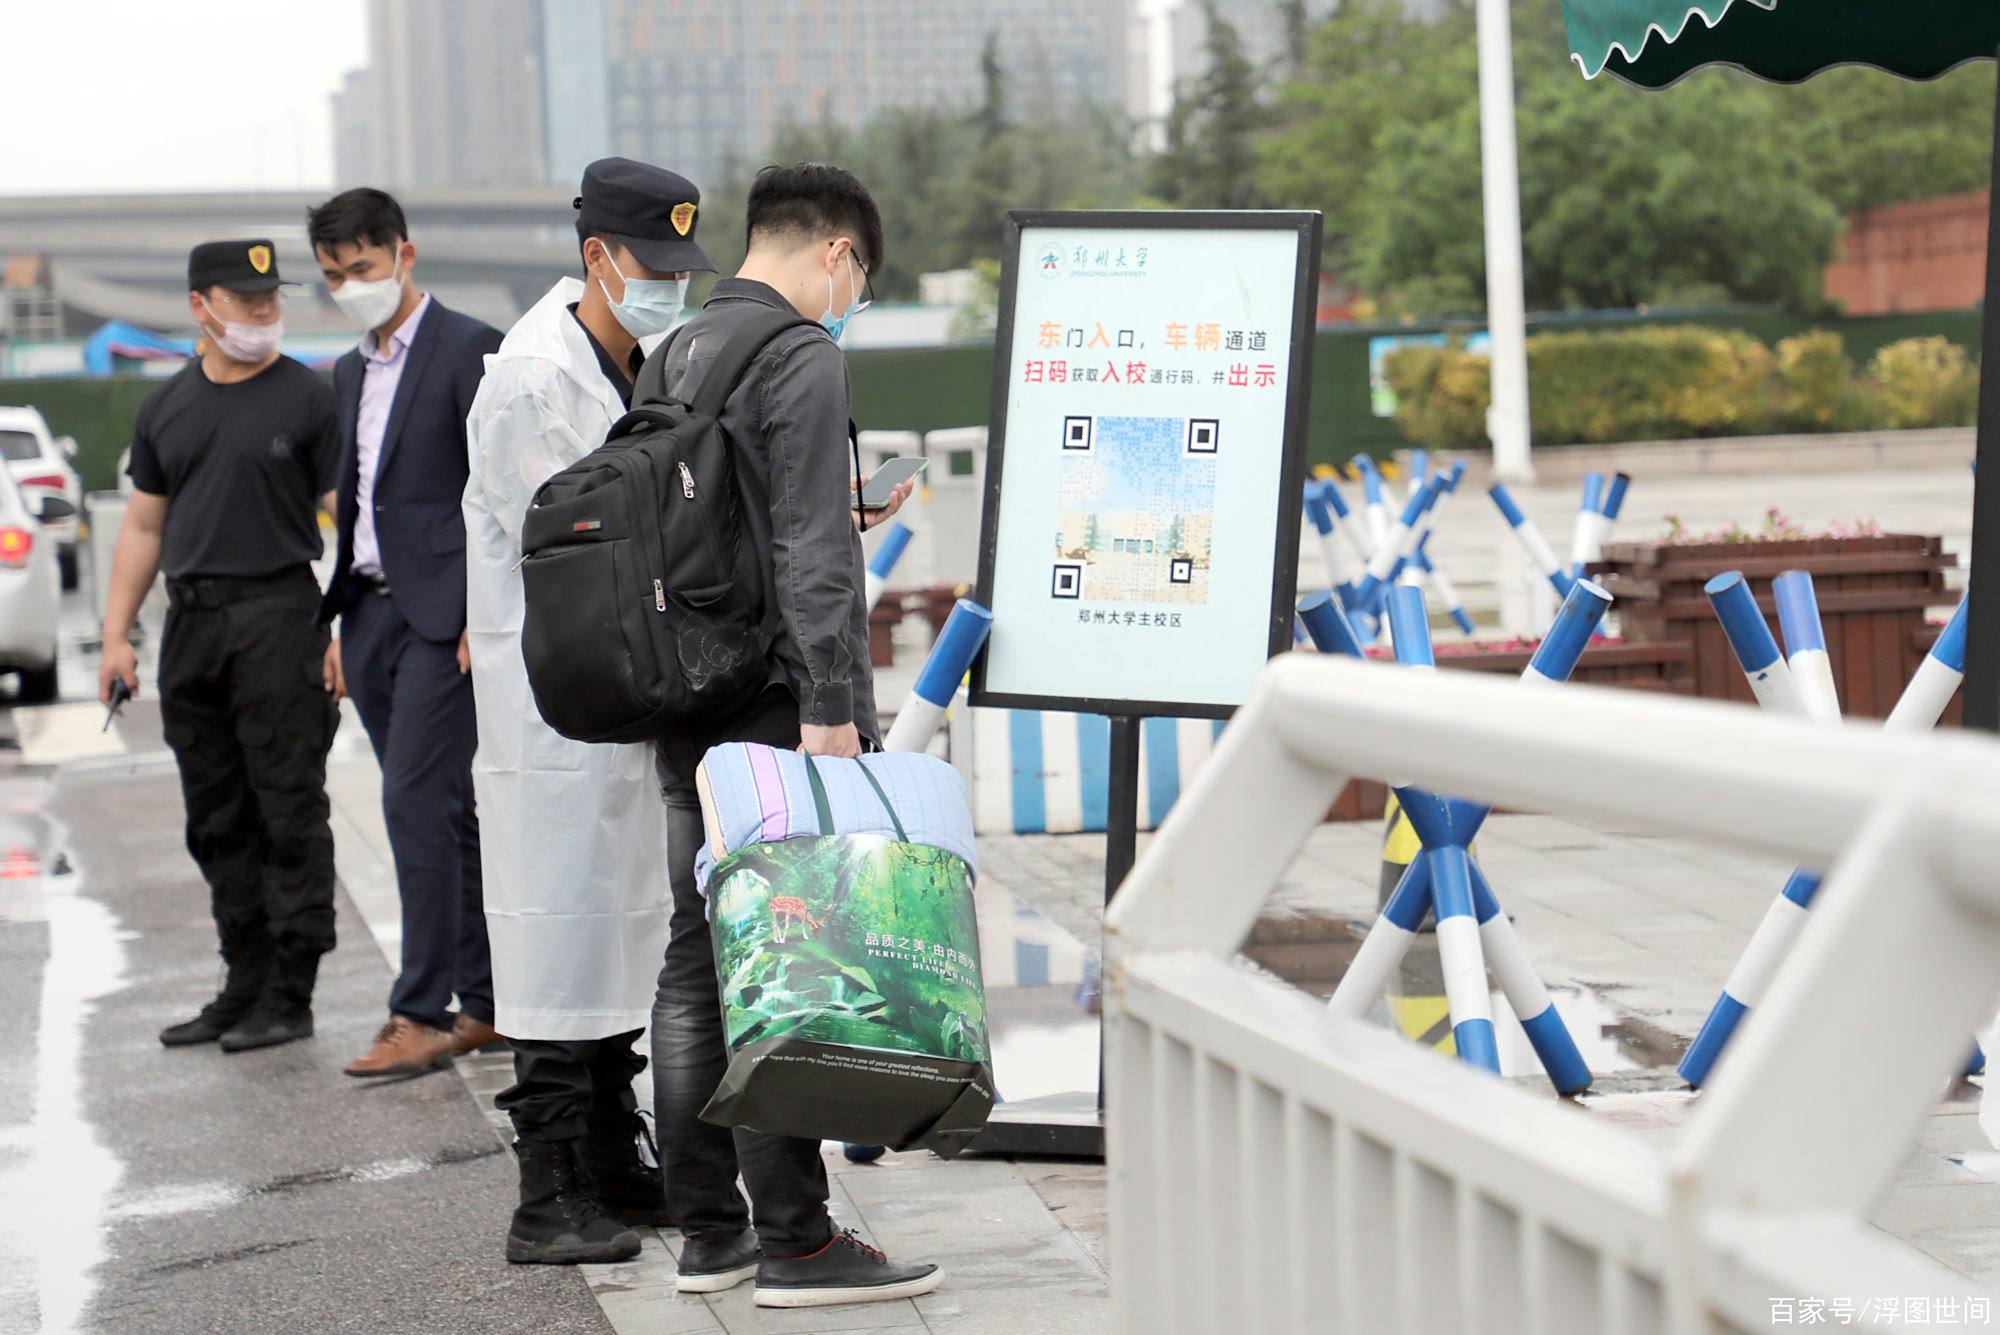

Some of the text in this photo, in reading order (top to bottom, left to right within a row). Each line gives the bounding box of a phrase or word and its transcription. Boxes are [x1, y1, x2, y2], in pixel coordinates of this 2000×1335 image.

[1071, 245, 1149, 268] 郑州大学
[1078, 609, 1182, 628] 郑州大学主校区
[868, 948, 945, 968] PERFECT LIFE
[912, 962, 958, 979] DIAMOND
[888, 1062, 911, 1071] greatest
